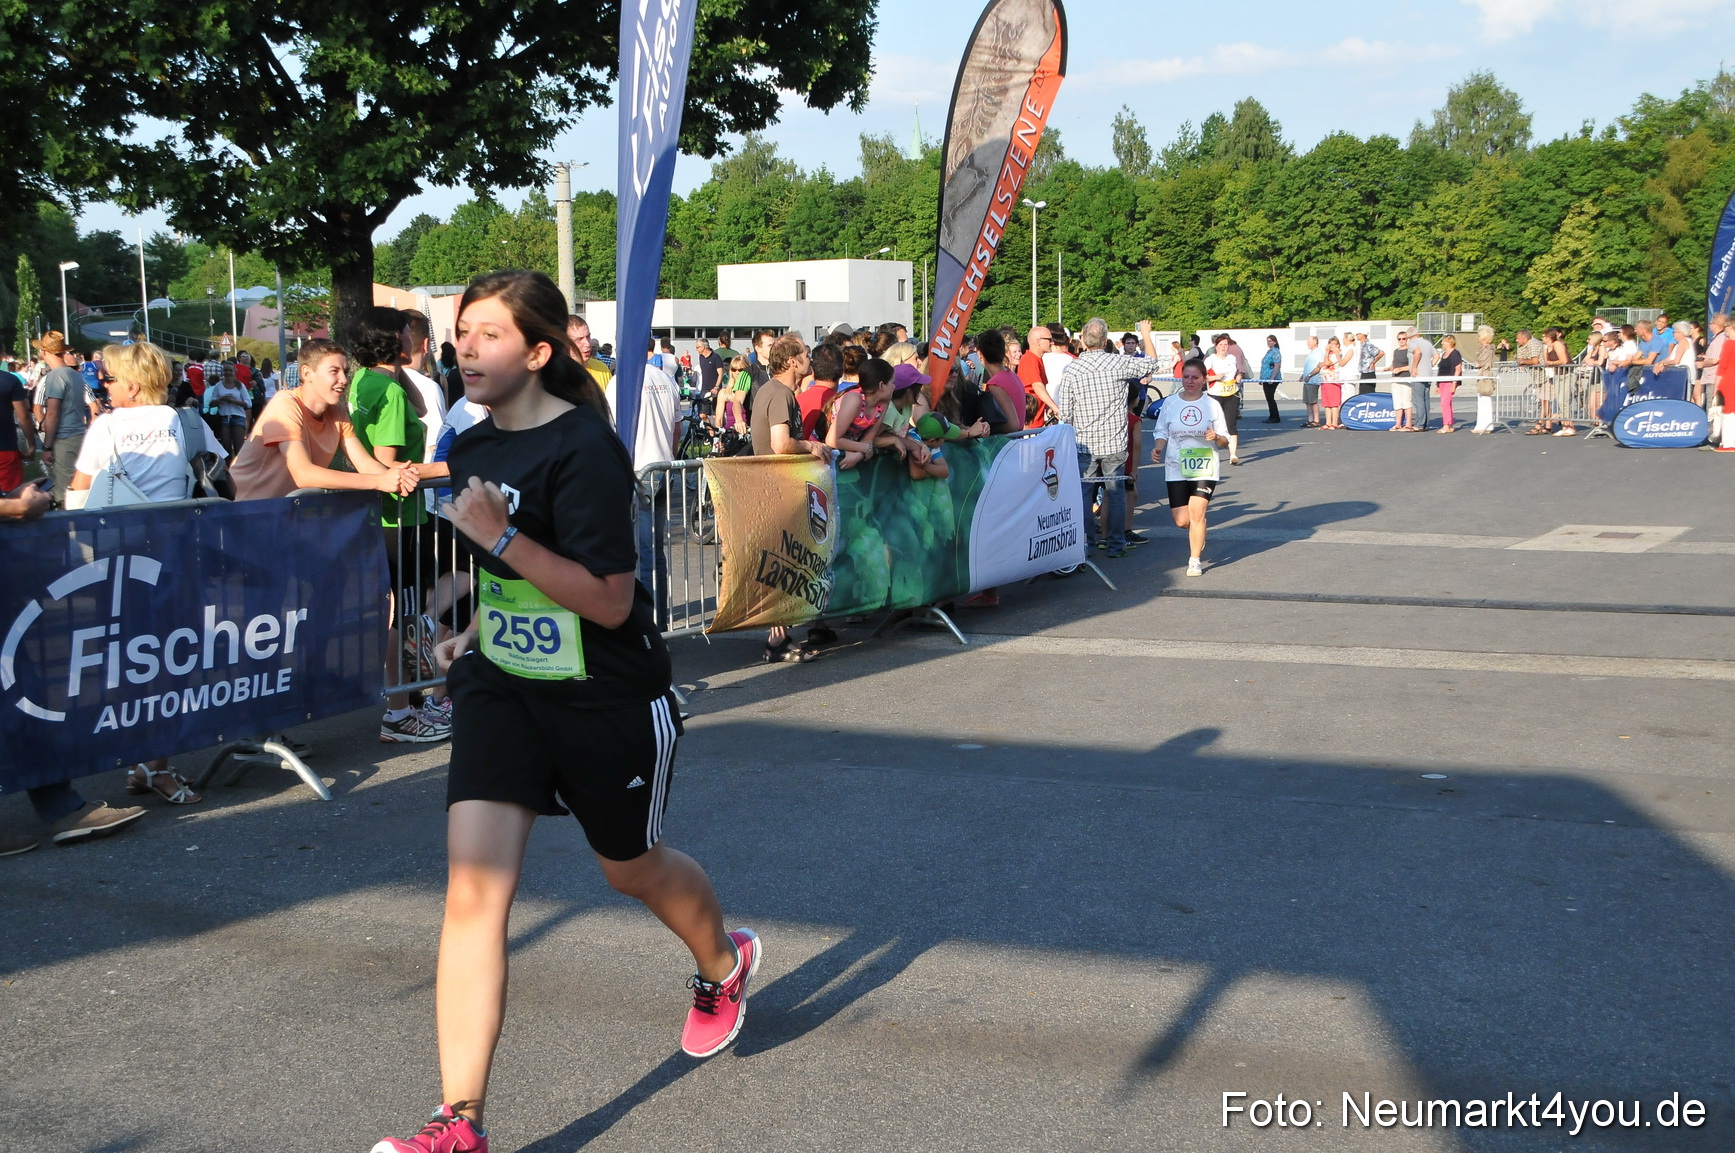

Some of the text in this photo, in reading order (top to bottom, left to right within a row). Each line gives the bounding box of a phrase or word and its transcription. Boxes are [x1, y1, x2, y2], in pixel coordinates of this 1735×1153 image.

[1711, 237, 1735, 296] Frischm
[1358, 409, 1396, 419] Fische
[1637, 420, 1699, 433] Fischer
[1181, 458, 1211, 470] 1027
[1037, 506, 1072, 532] Neumarkter
[1027, 523, 1077, 562] Lammsbräu
[756, 549, 829, 612] Lammsb
[68, 605, 308, 697] Fischer
[488, 610, 561, 655] 259
[526, 656, 549, 664] Siegert
[94, 667, 293, 734] AUTOMOBILE
